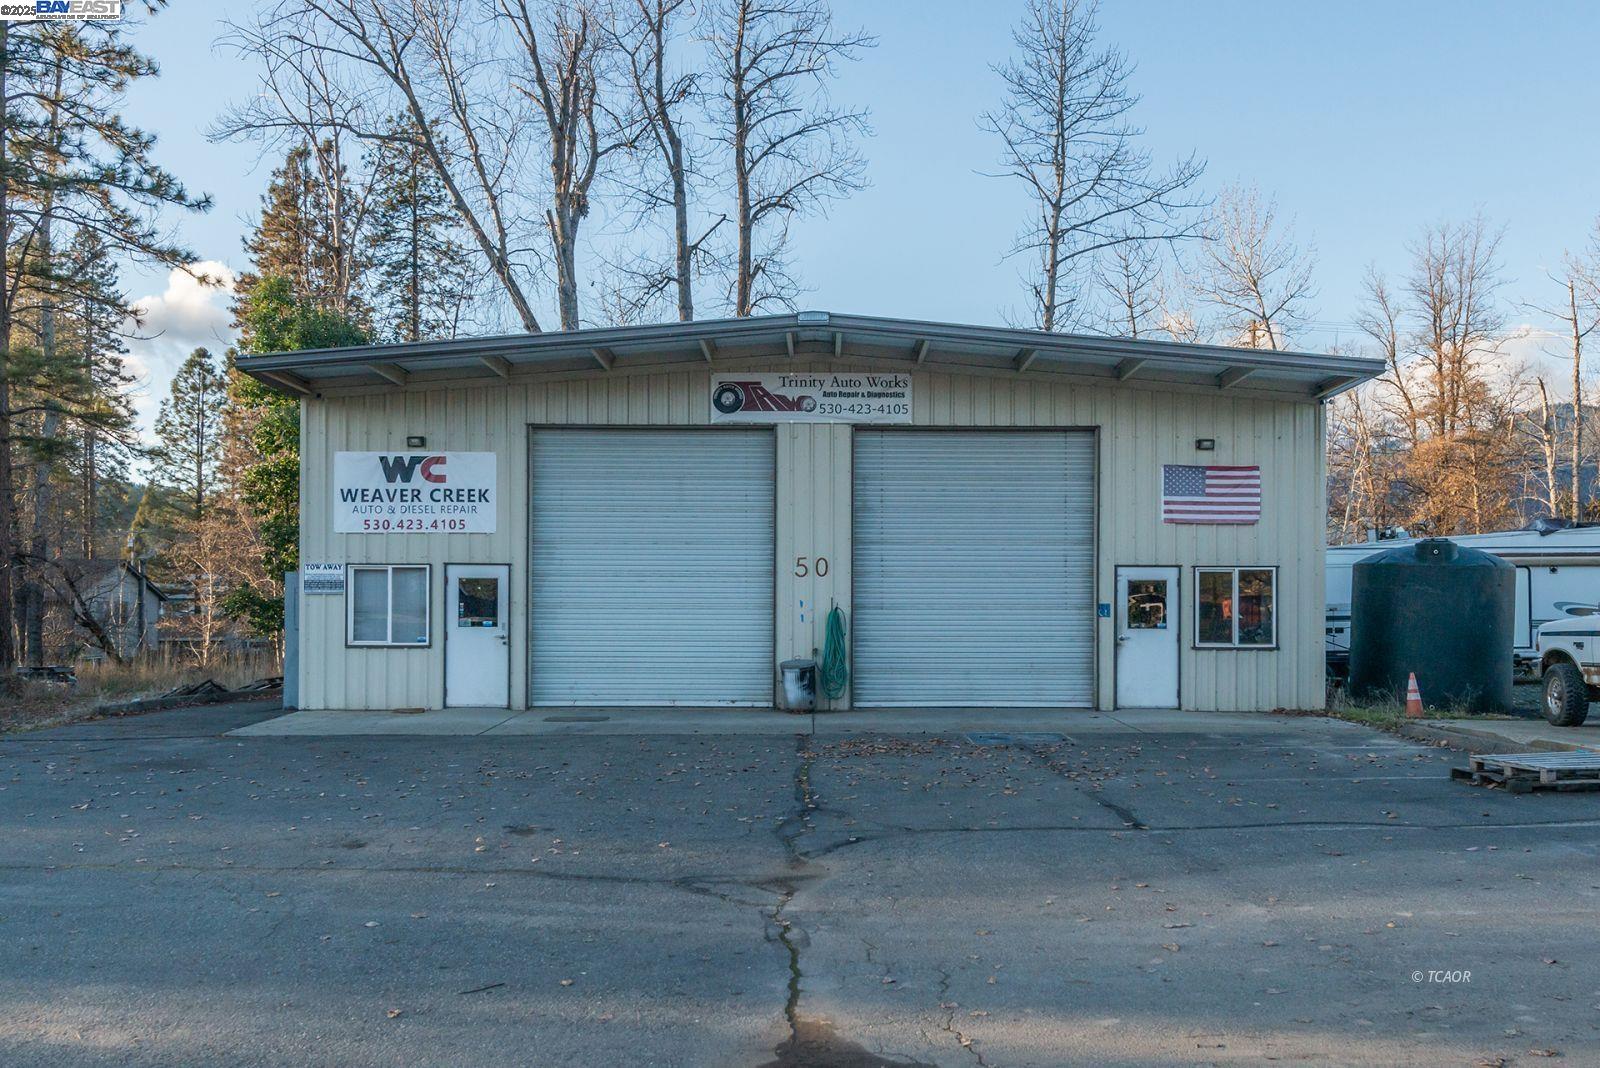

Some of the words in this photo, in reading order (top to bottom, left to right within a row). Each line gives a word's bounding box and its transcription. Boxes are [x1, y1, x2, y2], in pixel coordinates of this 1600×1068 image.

[779, 375, 826, 390] Trinity
[830, 375, 862, 388] Auto
[866, 375, 909, 389] Works
[822, 390, 837, 398] Auto
[838, 390, 860, 399] Repair
[867, 390, 906, 399] Diagnostics
[819, 403, 909, 415] 530-423-4105
[340, 488, 421, 503] WEAVER
[429, 488, 490, 503] CREEK
[352, 505, 383, 514] AUTO
[387, 505, 396, 514] &
[400, 505, 436, 514] DIESEL
[440, 505, 478, 514] REPAIR
[363, 519, 466, 531] 530.423.4105
[305, 563, 321, 571] TOW
[322, 563, 343, 571] AWAY
[795, 557, 828, 577] 50
